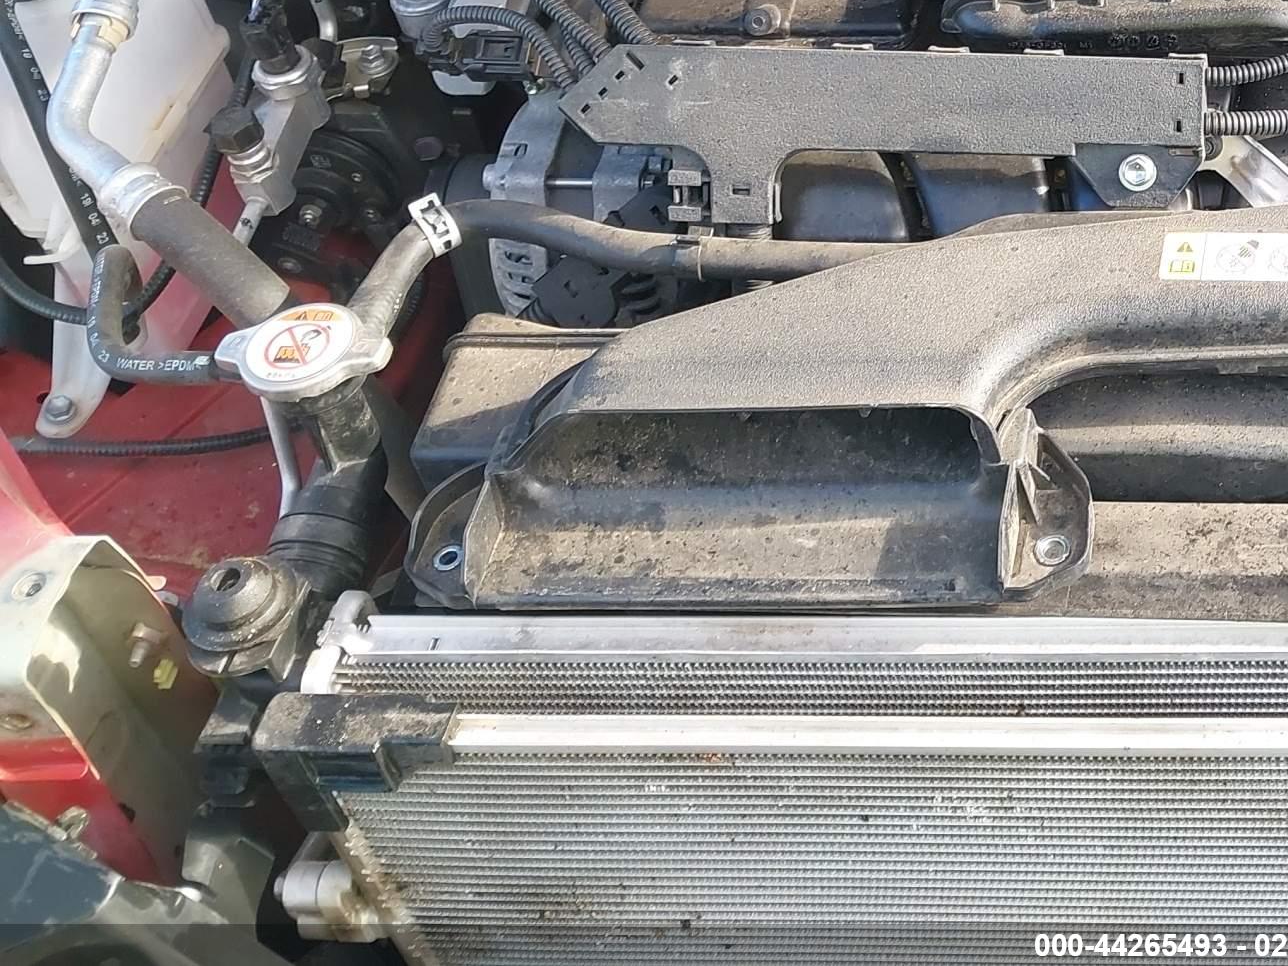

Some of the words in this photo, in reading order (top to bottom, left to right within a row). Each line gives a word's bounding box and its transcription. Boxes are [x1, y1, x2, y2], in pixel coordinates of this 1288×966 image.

[96, 231, 110, 245] 23
[98, 350, 109, 363] 23
[116, 357, 154, 371] WATER
